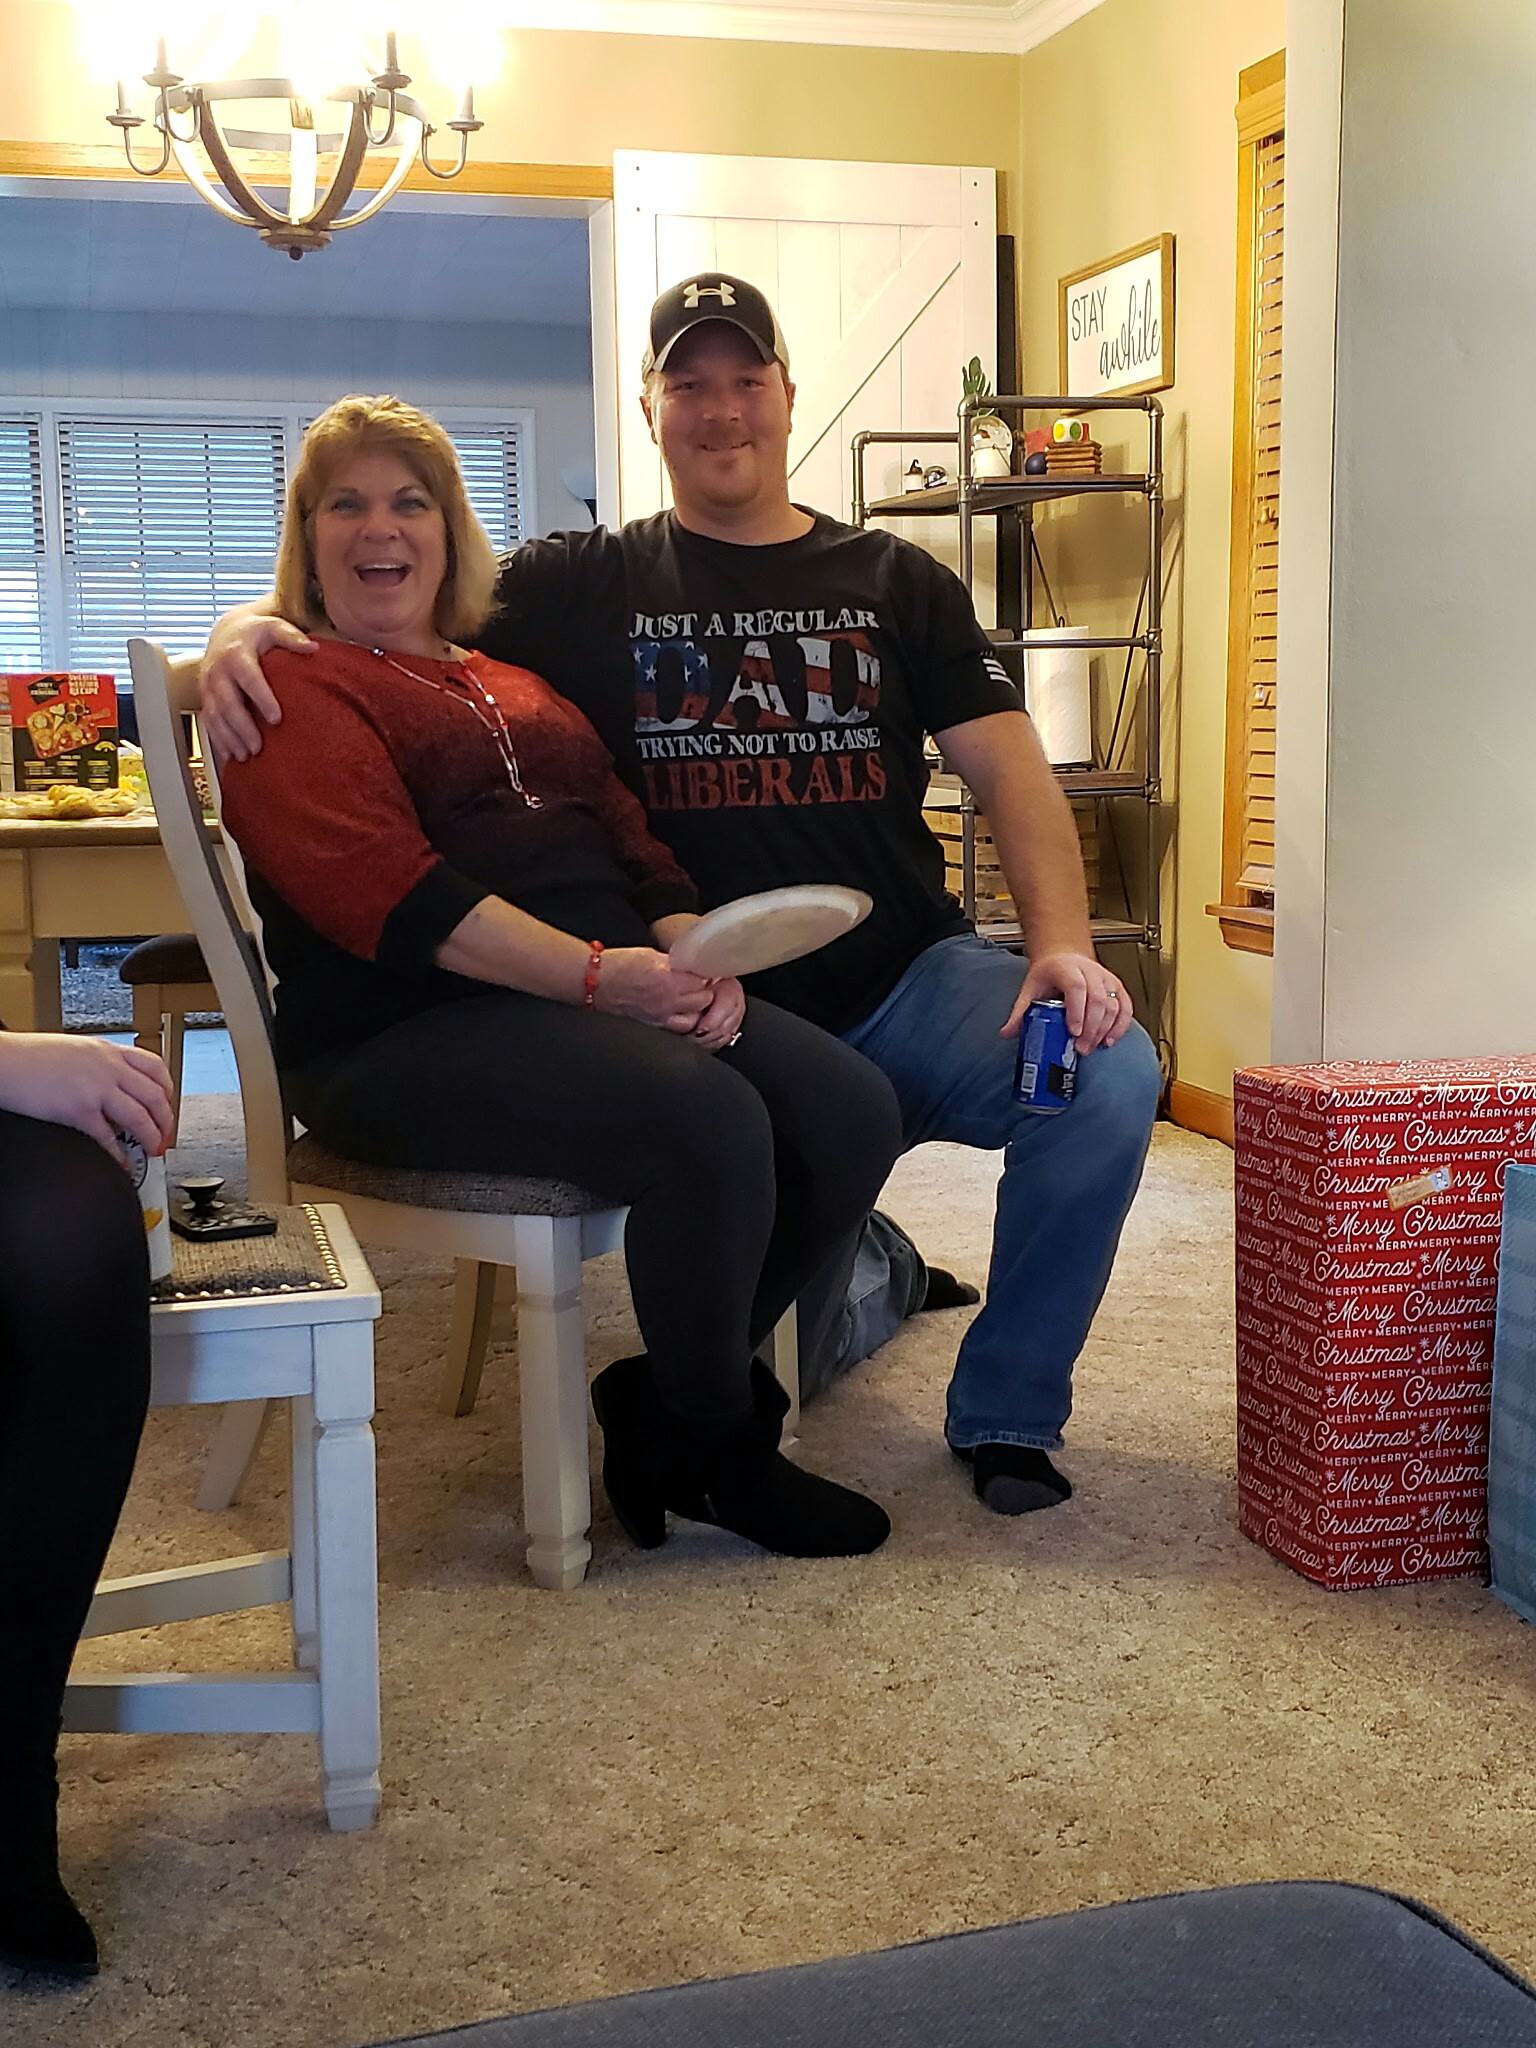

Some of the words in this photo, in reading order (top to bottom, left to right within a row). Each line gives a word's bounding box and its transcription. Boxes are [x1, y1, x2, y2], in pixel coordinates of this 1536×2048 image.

[1071, 286, 1107, 342] STAY
[1099, 279, 1161, 379] awhile
[629, 612, 699, 639] JUST
[704, 611, 728, 637] A
[732, 607, 880, 637] REGULAR
[629, 631, 882, 733] DAD
[636, 733, 723, 759] TRYING
[728, 732, 778, 756] NOT
[787, 730, 816, 754] TO
[820, 727, 882, 752] RAISE
[641, 751, 887, 811] LIBERALS
[1314, 1087, 1415, 1111] Christmas
[1423, 1080, 1491, 1110] Merry
[1325, 1114, 1366, 1124] MERRY
[1372, 1112, 1412, 1122] MERRY
[1422, 1110, 1461, 1120] MERRY
[1469, 1108, 1509, 1118] MERRY
[1514, 1107, 1536, 1117] MER
[1328, 1124, 1397, 1158] Merry
[1404, 1119, 1507, 1151] Christmas
[1327, 1157, 1368, 1167] MERRY
[1376, 1155, 1415, 1165] MERRY
[1420, 1152, 1458, 1162] MERRY
[1464, 1150, 1503, 1160] MERRY
[1514, 1148, 1536, 1158] MER
[1453, 1170, 1488, 1196] rry
[1325, 1200, 1366, 1210] MERRY
[1328, 1211, 1396, 1243] Merry
[1403, 1204, 1503, 1237] Christmas
[1327, 1242, 1368, 1253] MERRY
[1376, 1240, 1415, 1250] MERRY
[1420, 1237, 1457, 1248] MERRY
[1313, 1251, 1414, 1281] Christmas
[1422, 1247, 1487, 1280] Merry
[1325, 1285, 1366, 1296] MERRY
[1371, 1283, 1411, 1294] MERRY
[1421, 1280, 1459, 1290] MERRY
[1466, 1277, 1497, 1287] MERR
[1326, 1328, 1367, 1338] MERRY
[1375, 1325, 1414, 1336] MERRY
[1419, 1322, 1457, 1333] MERRY
[1463, 1319, 1494, 1330] MERR
[1327, 1296, 1396, 1329] Merry
[1313, 1336, 1414, 1366] Christmas
[1422, 1332, 1486, 1365] Merry
[1324, 1370, 1366, 1381] MERRY
[1372, 1368, 1411, 1379] MERRY
[1421, 1365, 1459, 1376] MERRY
[1327, 1381, 1396, 1415] Merry
[1403, 1375, 1493, 1407] Christma
[1326, 1414, 1367, 1424] MERRY
[1375, 1411, 1414, 1421] MERRY
[1419, 1407, 1457, 1418] MERRY
[1313, 1421, 1413, 1451] Christmas
[1420, 1417, 1485, 1448] Merry
[1325, 1456, 1365, 1467] MERRY
[1371, 1453, 1409, 1464] MERRY
[1419, 1448, 1456, 1459] MERRY
[1464, 1445, 1487, 1456] MER
[1327, 1466, 1394, 1499] Merry
[1401, 1459, 1489, 1491] Christma
[1326, 1499, 1366, 1509] MERRY
[1375, 1495, 1413, 1506] MERRY
[1418, 1490, 1456, 1502] MERRY
[1462, 1488, 1485, 1498] MER
[1315, 1505, 1412, 1535] Christmas
[1421, 1501, 1485, 1533] Merry
[1325, 1541, 1365, 1552] MERRY
[1371, 1537, 1409, 1549] MERRY
[1420, 1533, 1457, 1543] MERRY
[1328, 1551, 1394, 1583] Merry
